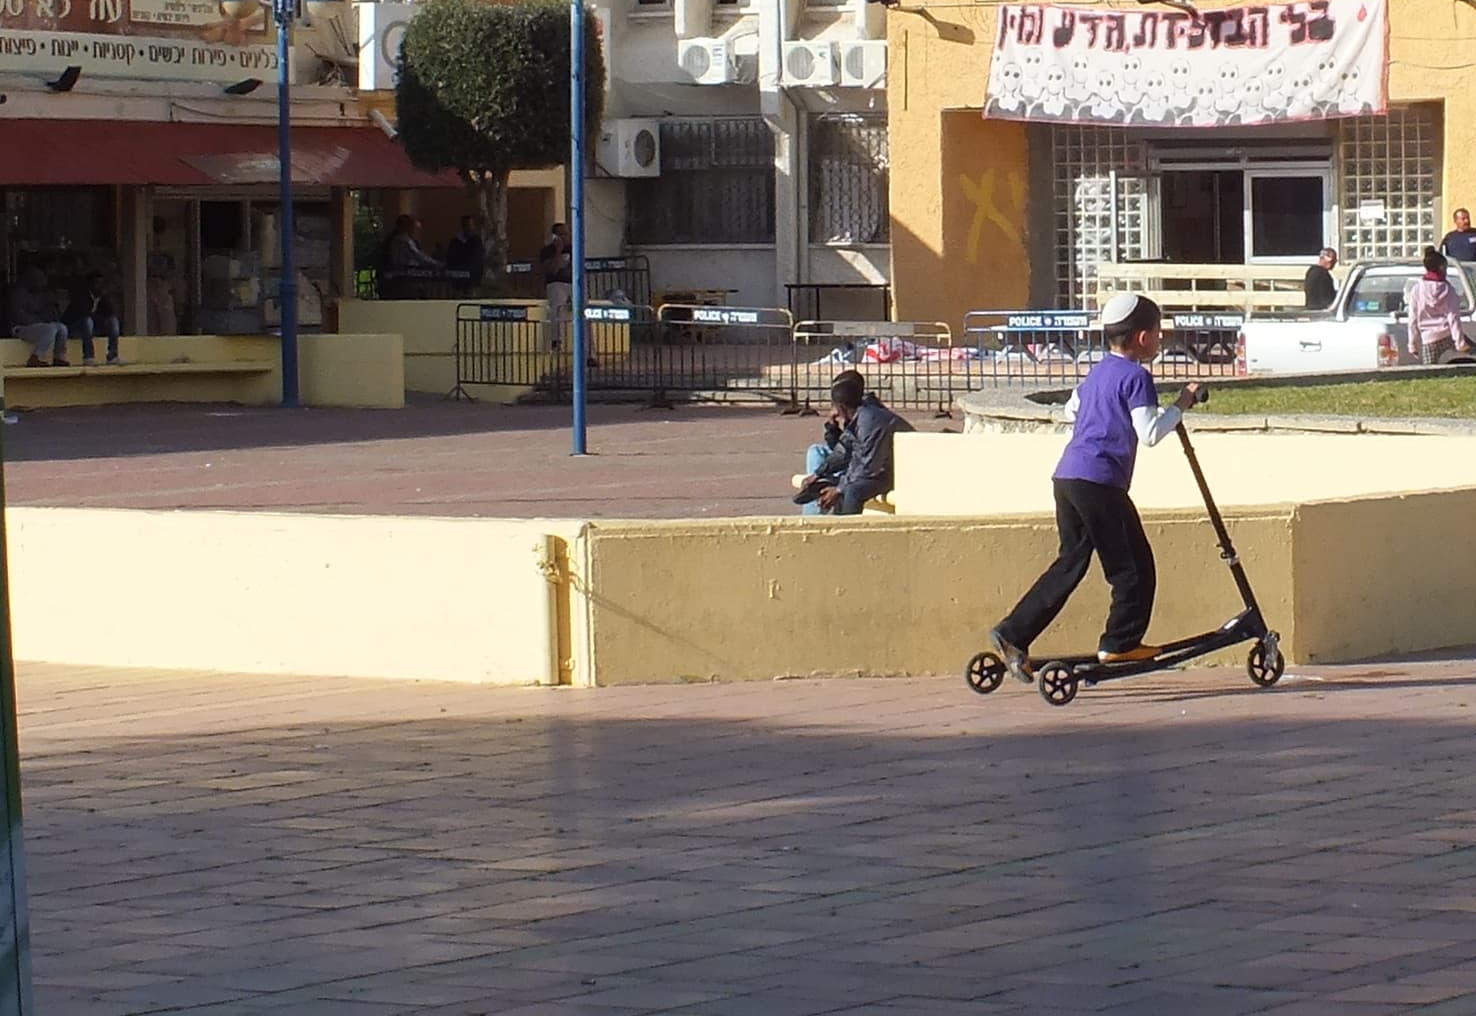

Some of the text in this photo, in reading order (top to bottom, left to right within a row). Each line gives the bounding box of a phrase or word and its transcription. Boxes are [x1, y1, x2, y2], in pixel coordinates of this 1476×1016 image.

[192, 47, 227, 66] פירות
[240, 49, 279, 69] בלינים
[1008, 315, 1042, 327] POLICE
[1174, 315, 1204, 327] POLICE
